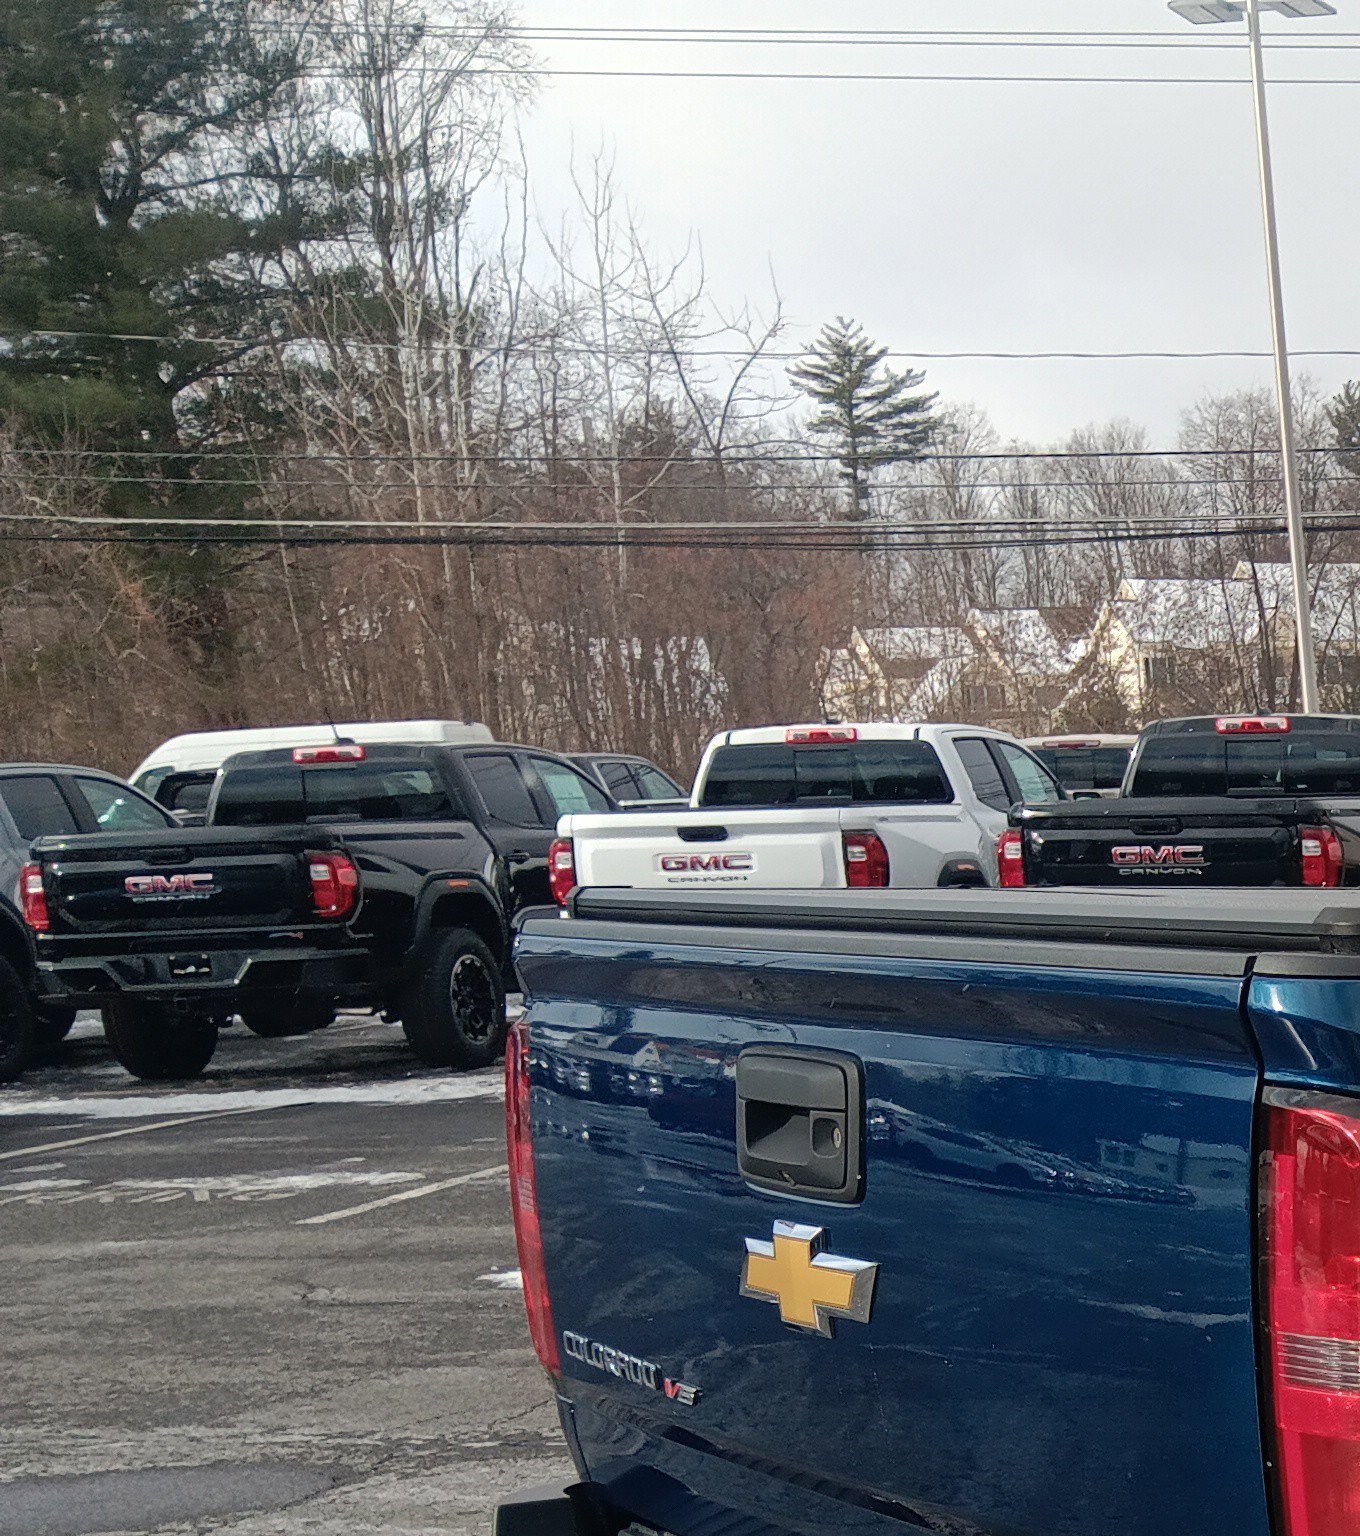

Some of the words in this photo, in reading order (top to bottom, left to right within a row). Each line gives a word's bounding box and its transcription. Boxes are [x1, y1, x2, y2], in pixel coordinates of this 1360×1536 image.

[661, 855, 753, 872] GMC
[1111, 845, 1204, 865] GMC
[1119, 867, 1203, 876] CANYON
[124, 873, 215, 894] GMC
[562, 1330, 663, 1391] COLORADO
